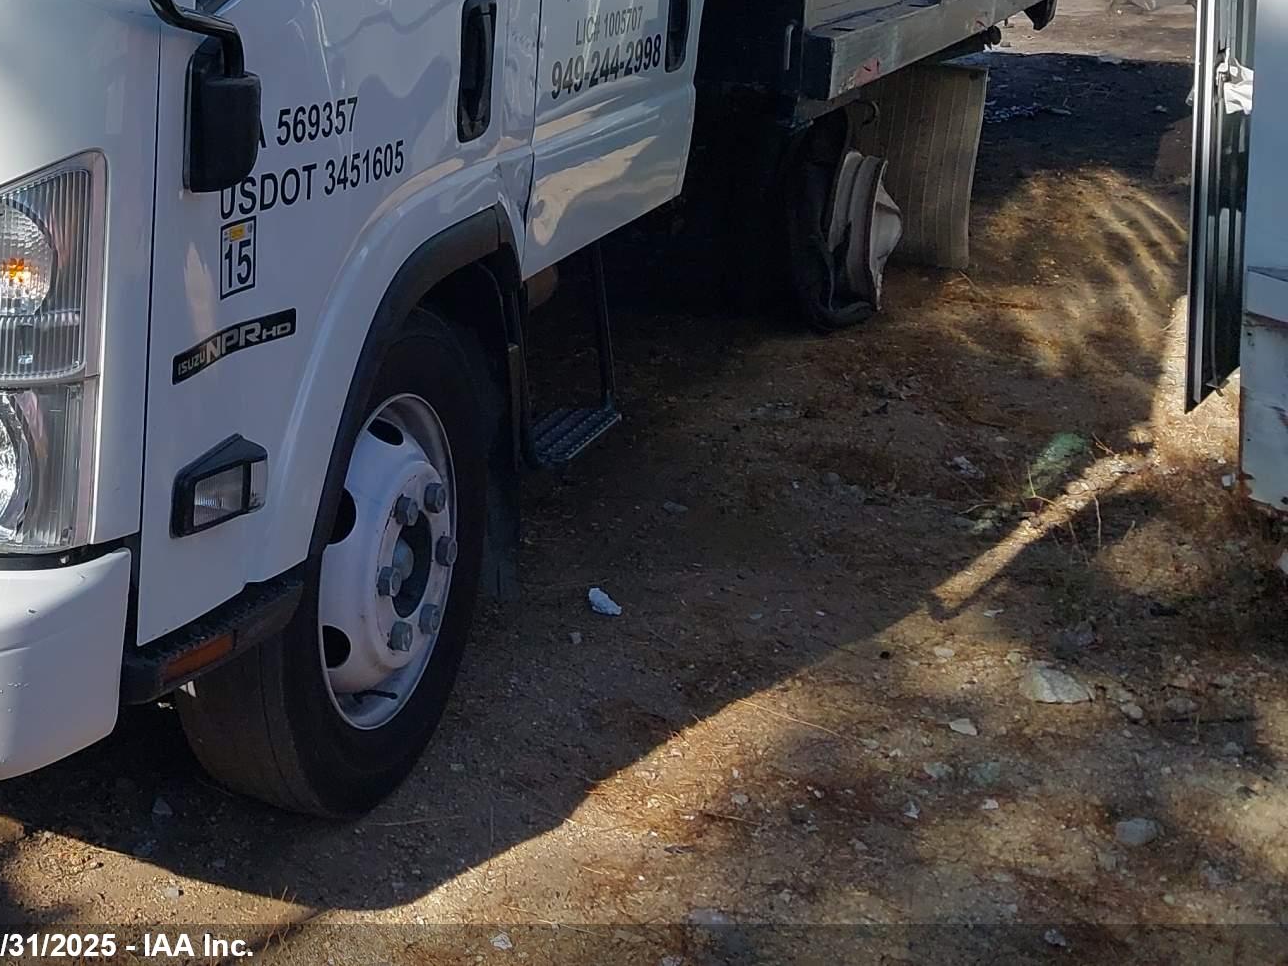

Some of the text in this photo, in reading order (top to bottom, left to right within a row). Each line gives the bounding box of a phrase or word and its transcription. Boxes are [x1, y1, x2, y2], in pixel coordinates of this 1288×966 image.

[575, 6, 644, 46] LIC# 1005707
[551, 33, 662, 100] 949-244-2998
[276, 96, 358, 147] 569357
[220, 140, 404, 221] USDOT 3451605
[224, 239, 252, 289] 15
[178, 322, 292, 376] ISUZU NPR HD
